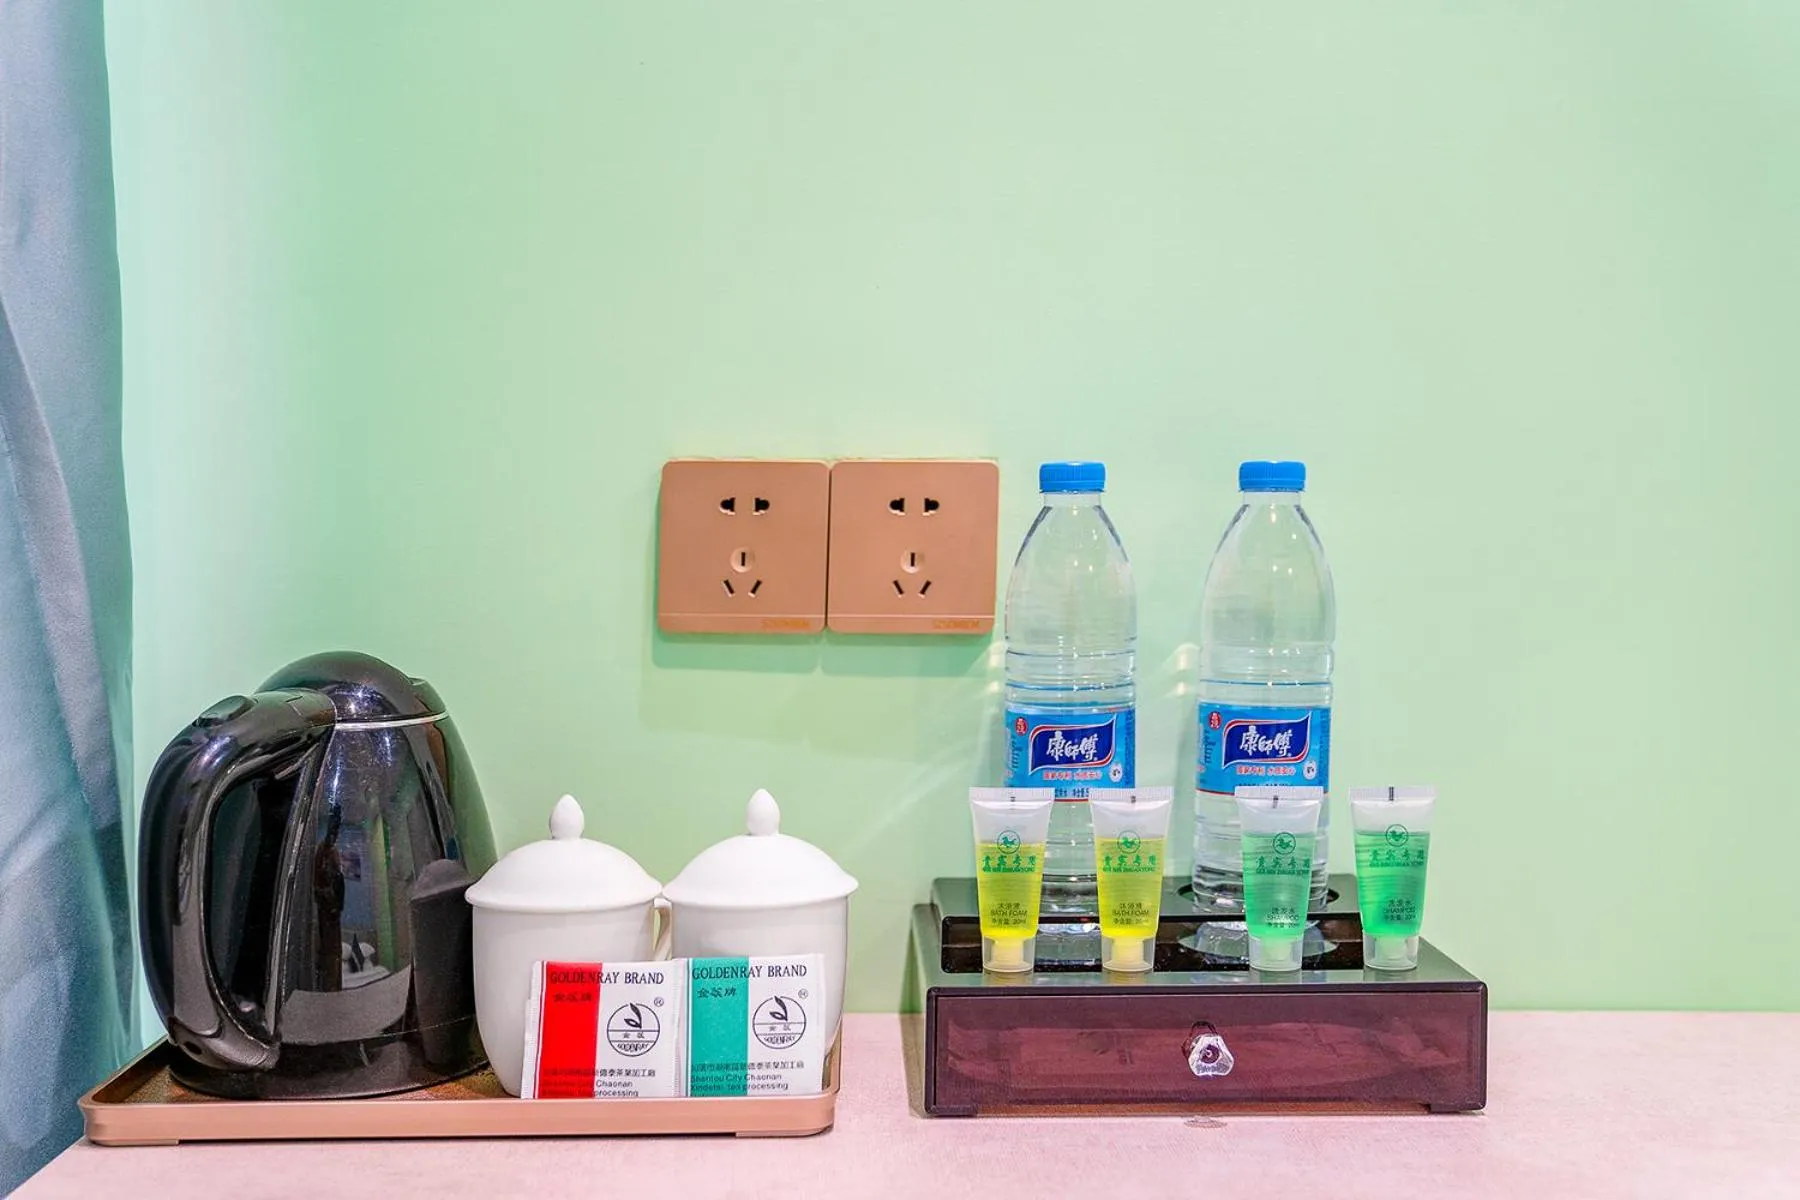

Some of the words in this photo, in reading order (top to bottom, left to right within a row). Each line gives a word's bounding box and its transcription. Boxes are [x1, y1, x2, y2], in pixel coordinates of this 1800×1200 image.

[692, 965, 762, 980] GOLDENRAY
[767, 965, 807, 978] BRAND
[550, 971, 618, 985] GOLDENRAY
[625, 971, 664, 985] BRAND
[744, 1073, 782, 1081] Chaonan
[596, 1080, 633, 1088] Chaonan
[743, 1083, 789, 1092] processing
[594, 1089, 639, 1097] processing
